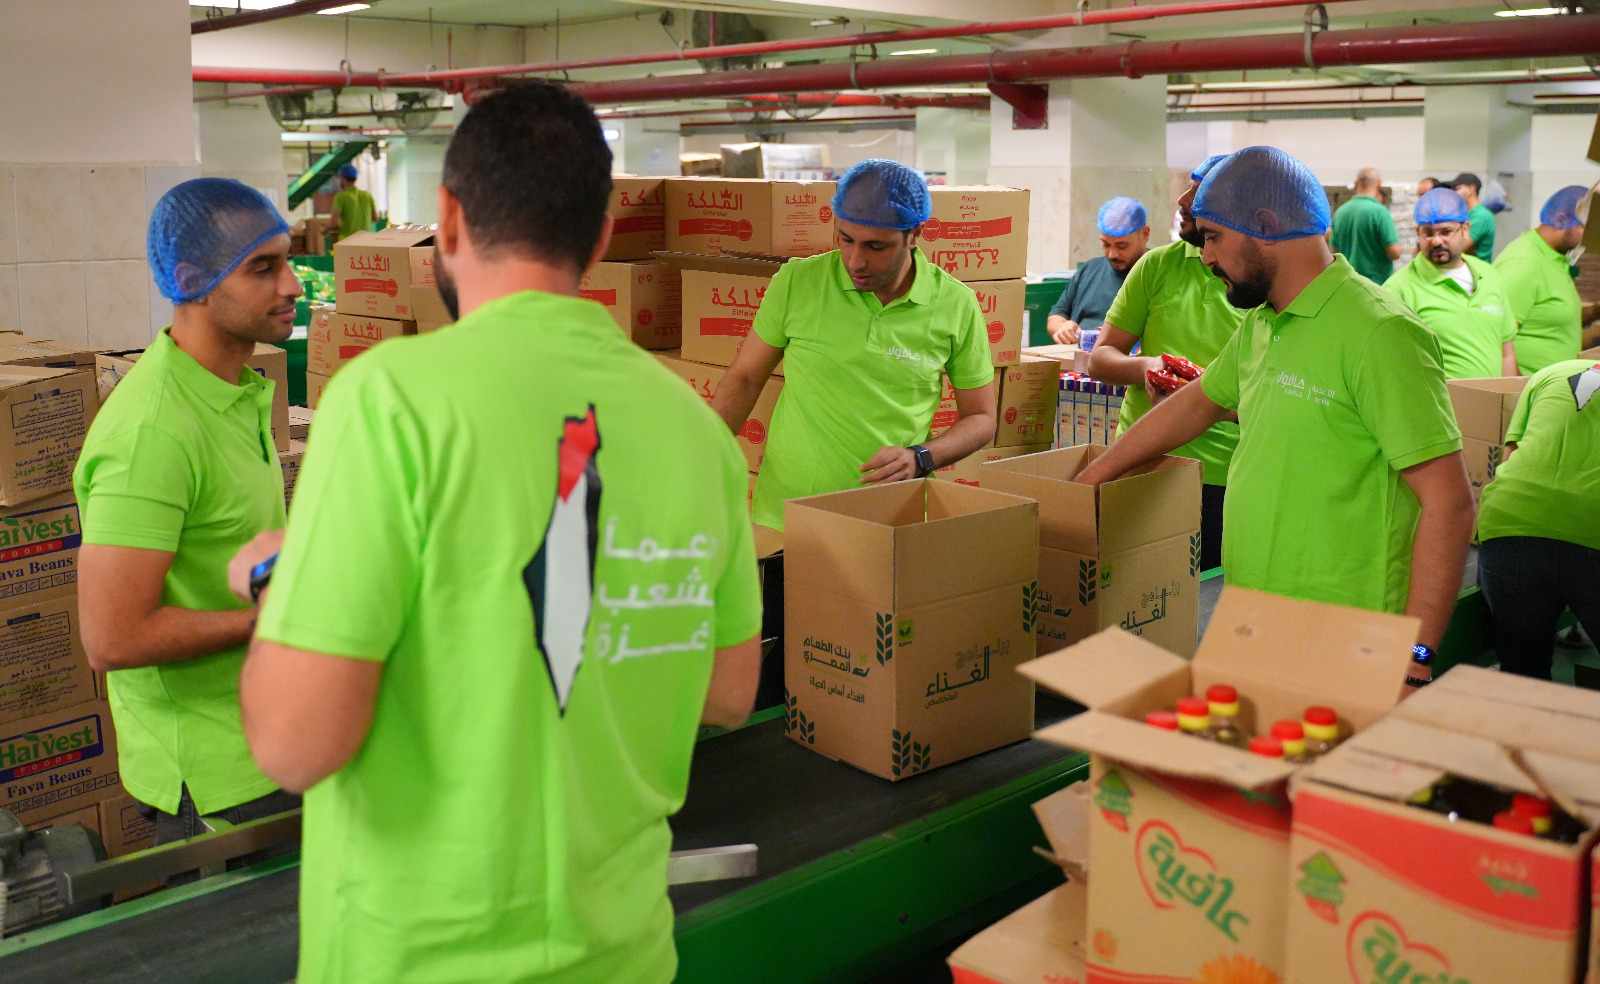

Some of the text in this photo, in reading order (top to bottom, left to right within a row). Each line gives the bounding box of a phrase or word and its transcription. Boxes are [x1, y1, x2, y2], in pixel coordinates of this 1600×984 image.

[0, 513, 75, 547] arvest
[0, 557, 73, 581] ava Beans
[599, 566, 713, 616] شعب
[595, 620, 710, 664] غزة
[8, 767, 93, 799] Fava Beans
[1147, 832, 1250, 943] عافية
